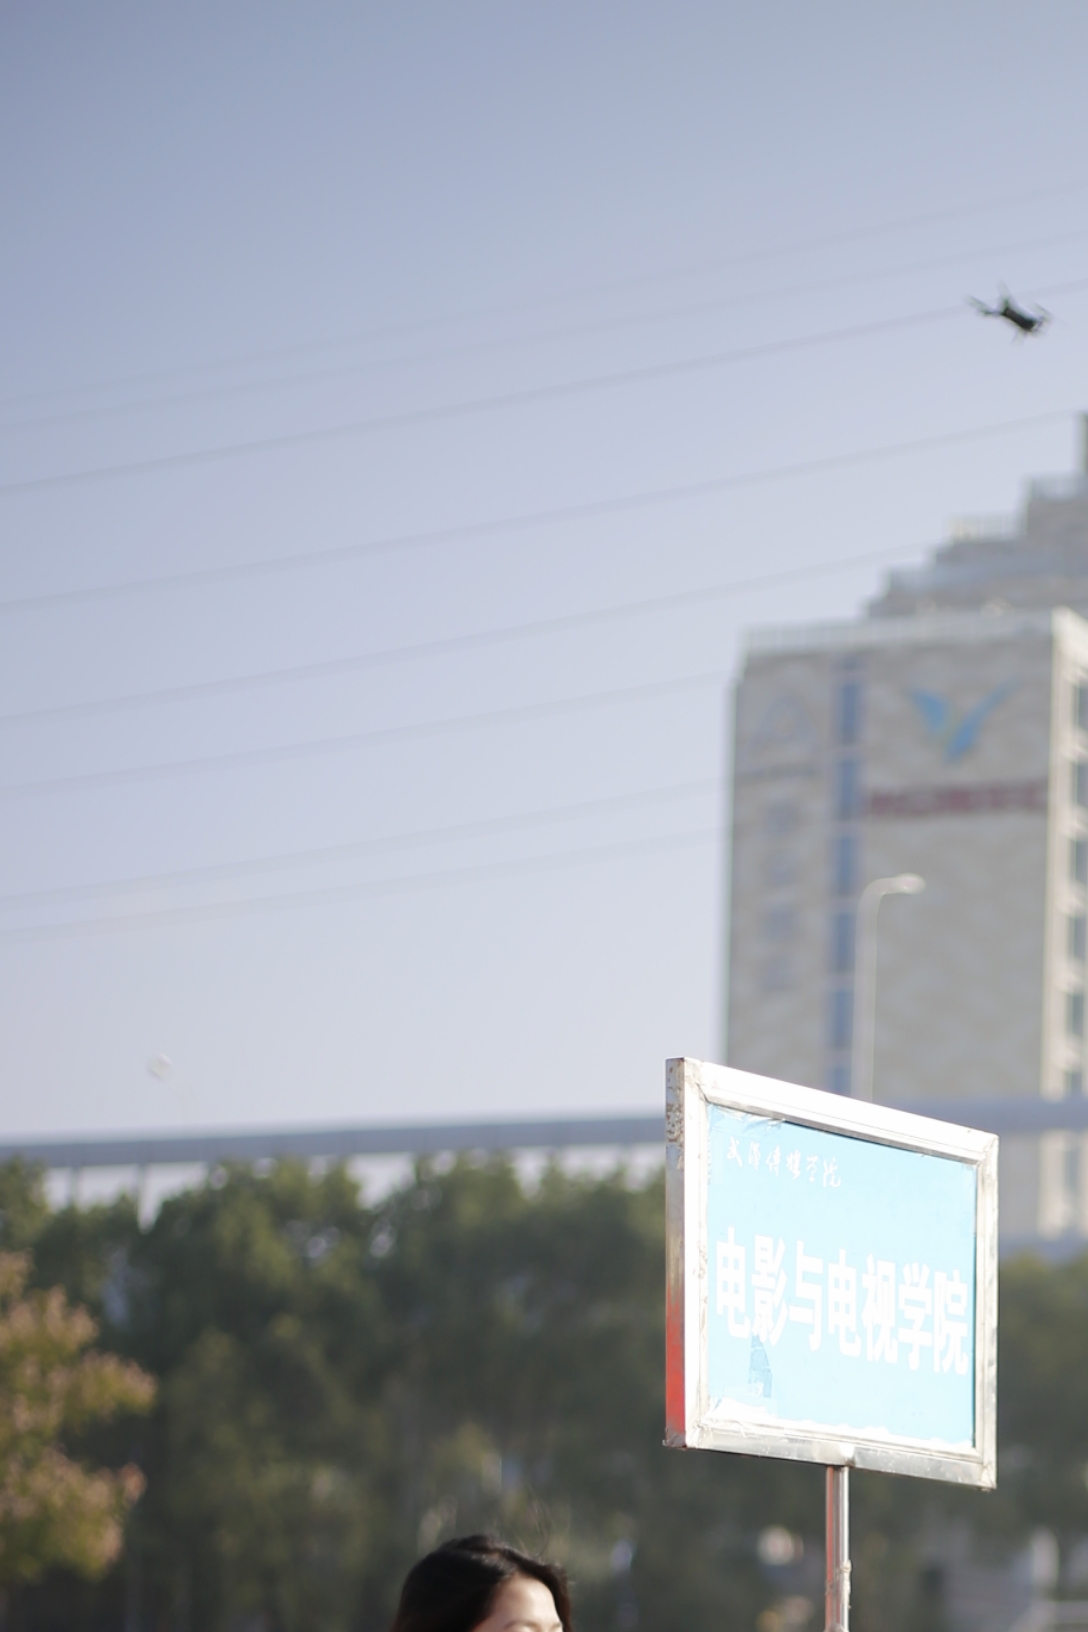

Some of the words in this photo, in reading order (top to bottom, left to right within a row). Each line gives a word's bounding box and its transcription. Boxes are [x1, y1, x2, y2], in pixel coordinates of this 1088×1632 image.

[715, 1224, 969, 1376] 电影与电视学院
